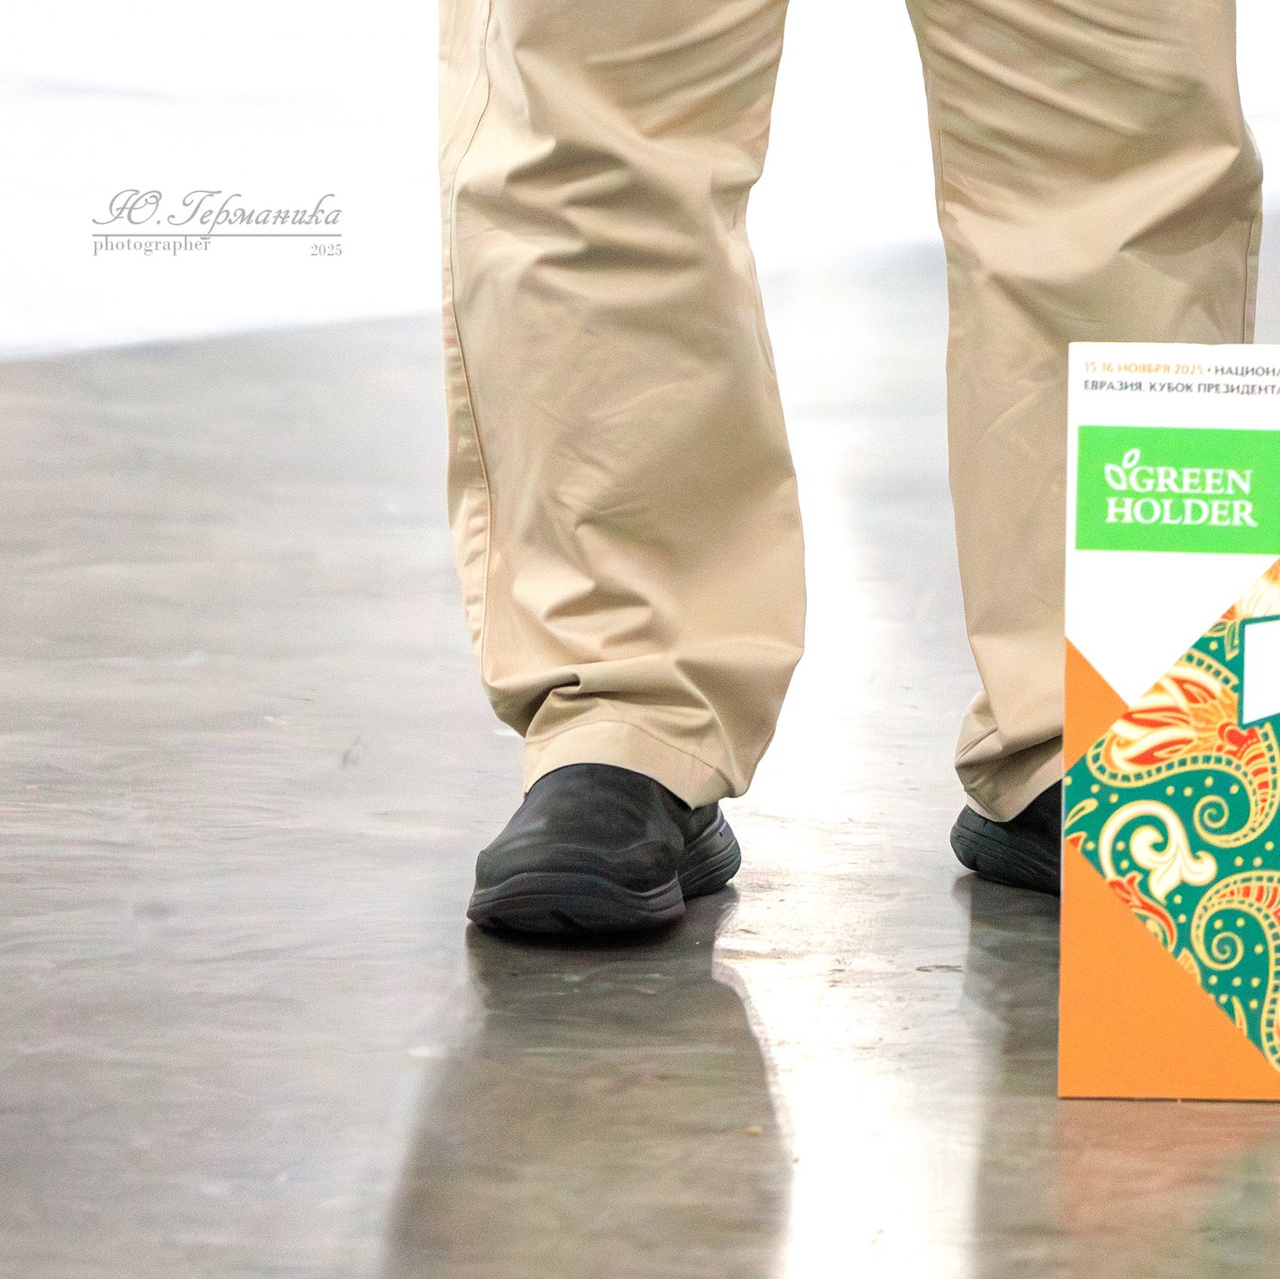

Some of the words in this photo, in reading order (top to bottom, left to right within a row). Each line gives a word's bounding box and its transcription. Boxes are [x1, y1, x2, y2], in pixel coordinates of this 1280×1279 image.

[1117, 362, 1171, 374] НОЯБРЯ
[1174, 363, 1204, 375] 2025
[1149, 381, 1193, 393] КУБОК
[1129, 462, 1253, 496] GREEN
[1105, 497, 1258, 528] HOLDER
